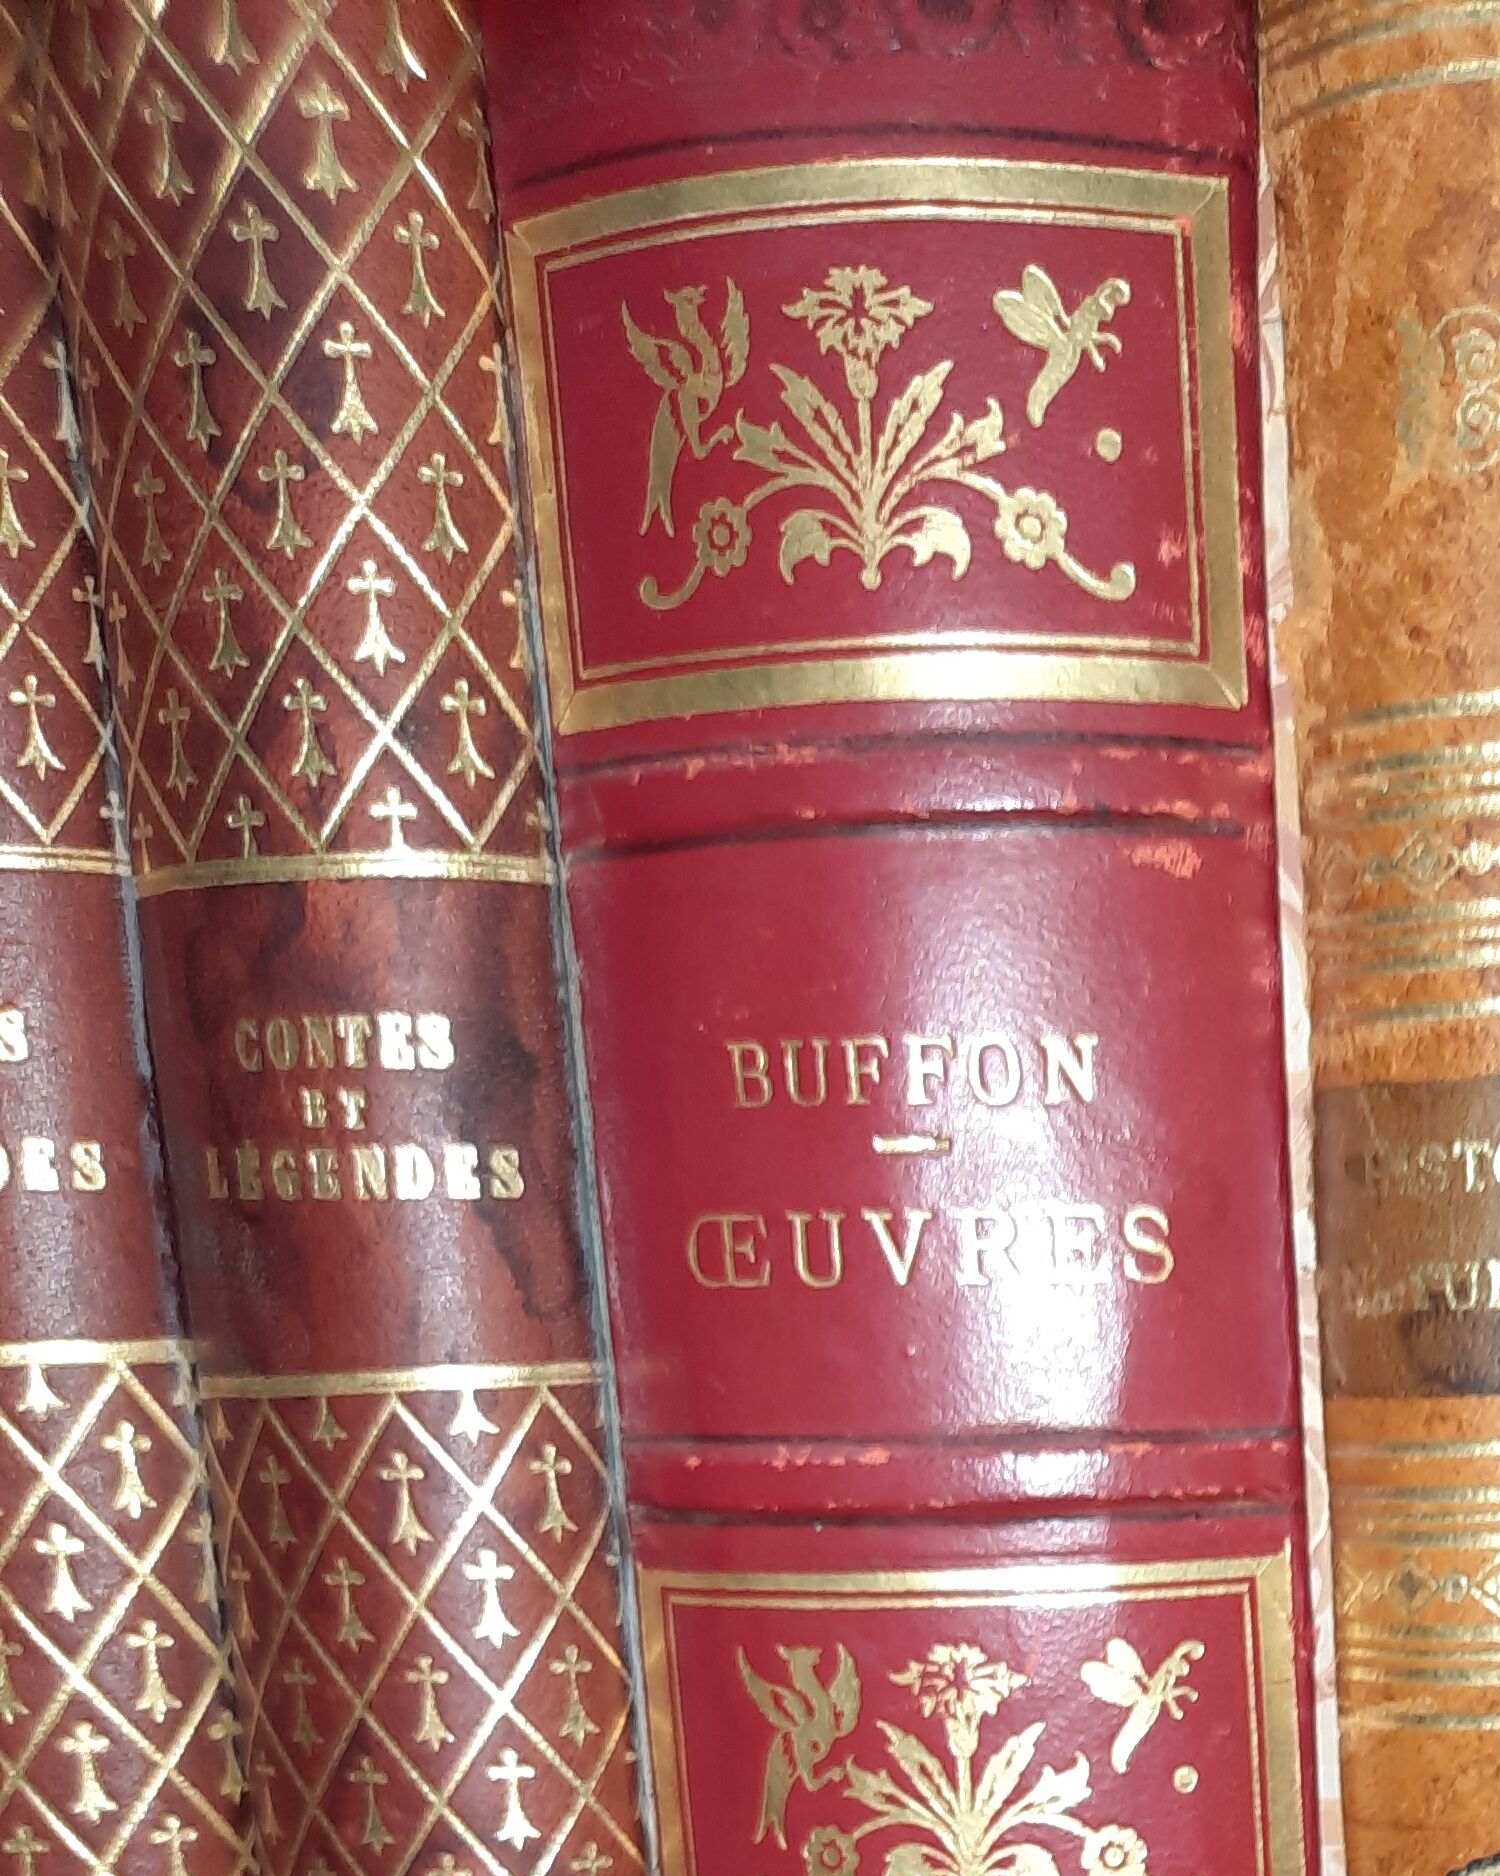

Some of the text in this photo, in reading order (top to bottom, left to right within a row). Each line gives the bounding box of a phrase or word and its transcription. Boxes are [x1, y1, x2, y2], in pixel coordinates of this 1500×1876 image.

[234, 1010, 456, 1072] CONTES
[726, 1030, 1100, 1110] BUFFON
[300, 1086, 369, 1131] ET
[687, 1202, 1176, 1289] ŒUVRES
